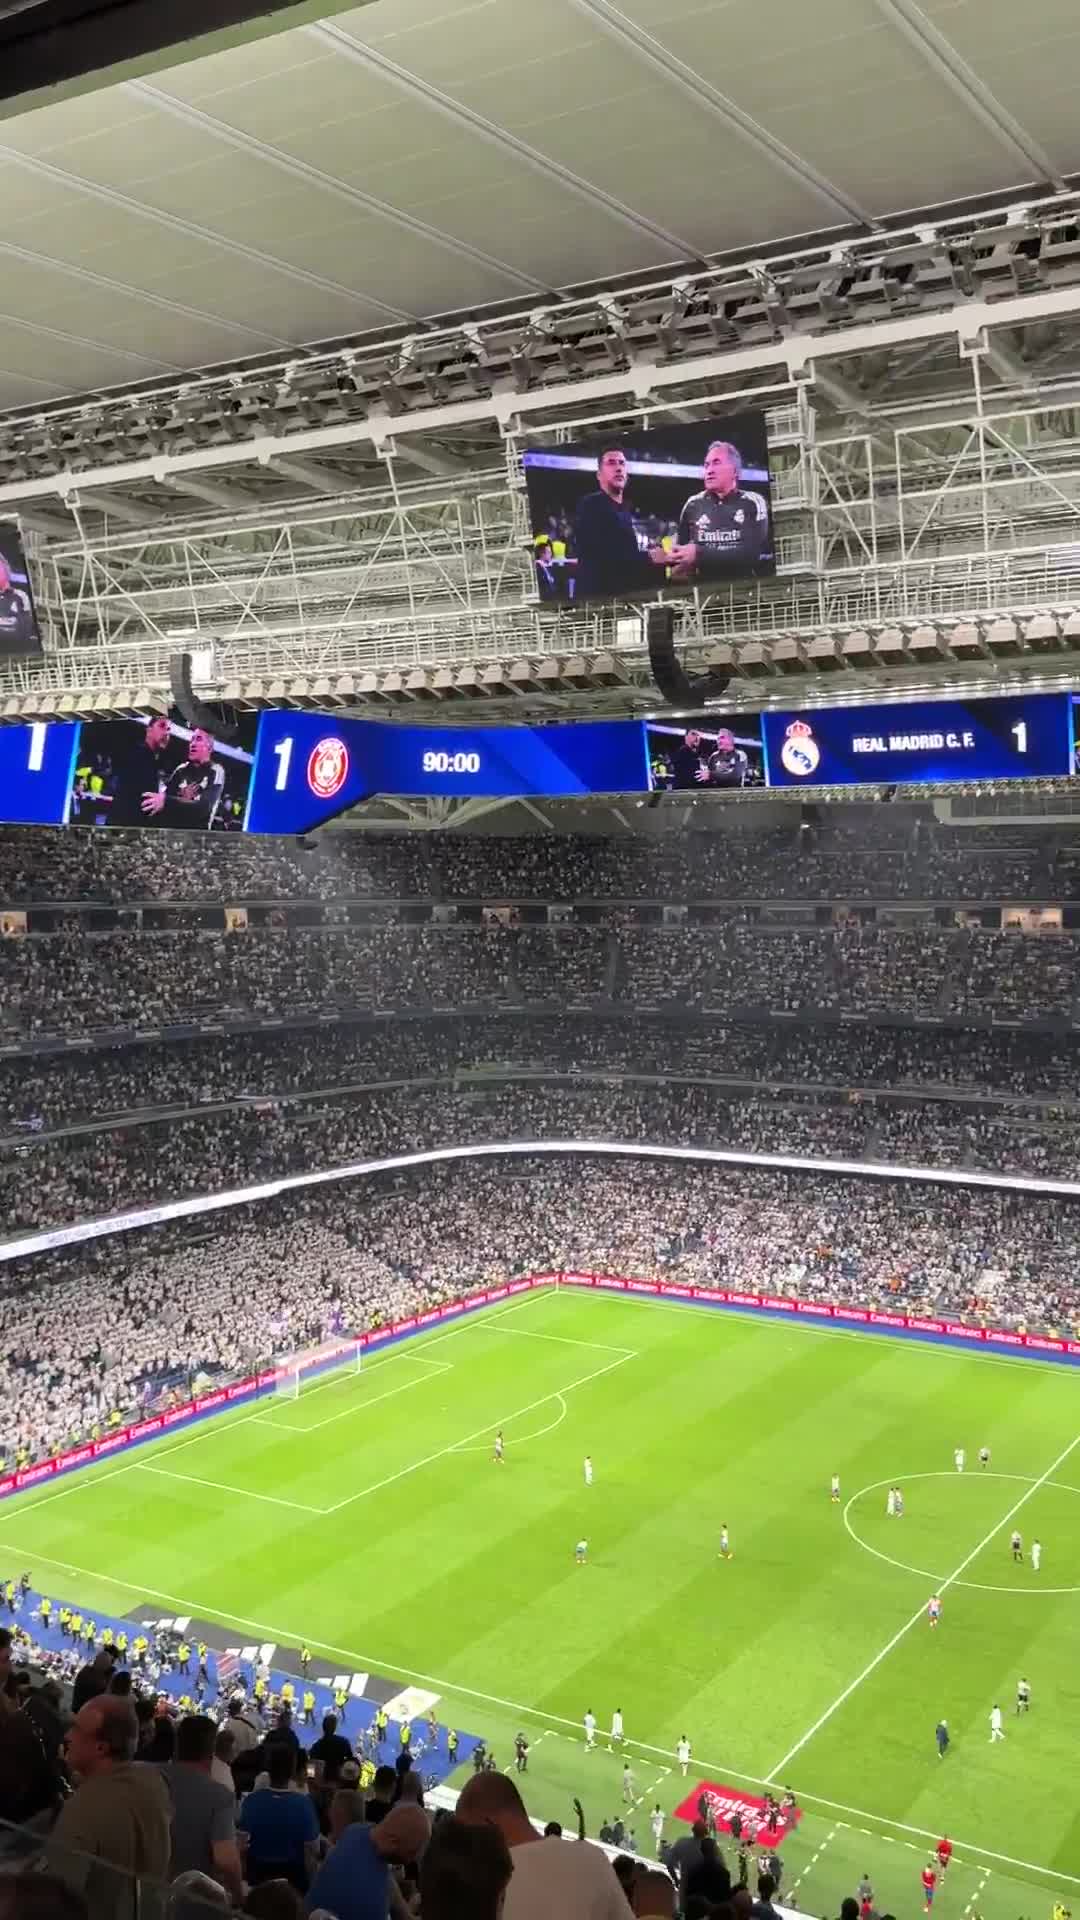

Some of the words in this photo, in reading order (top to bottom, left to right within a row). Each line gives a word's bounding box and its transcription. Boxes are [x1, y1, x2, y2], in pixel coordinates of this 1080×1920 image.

[853, 737, 888, 752] REAL
[889, 734, 944, 750] MADRID
[1011, 722, 1027, 752] 1
[274, 737, 293, 790] 1
[423, 752, 480, 773] 90:00
